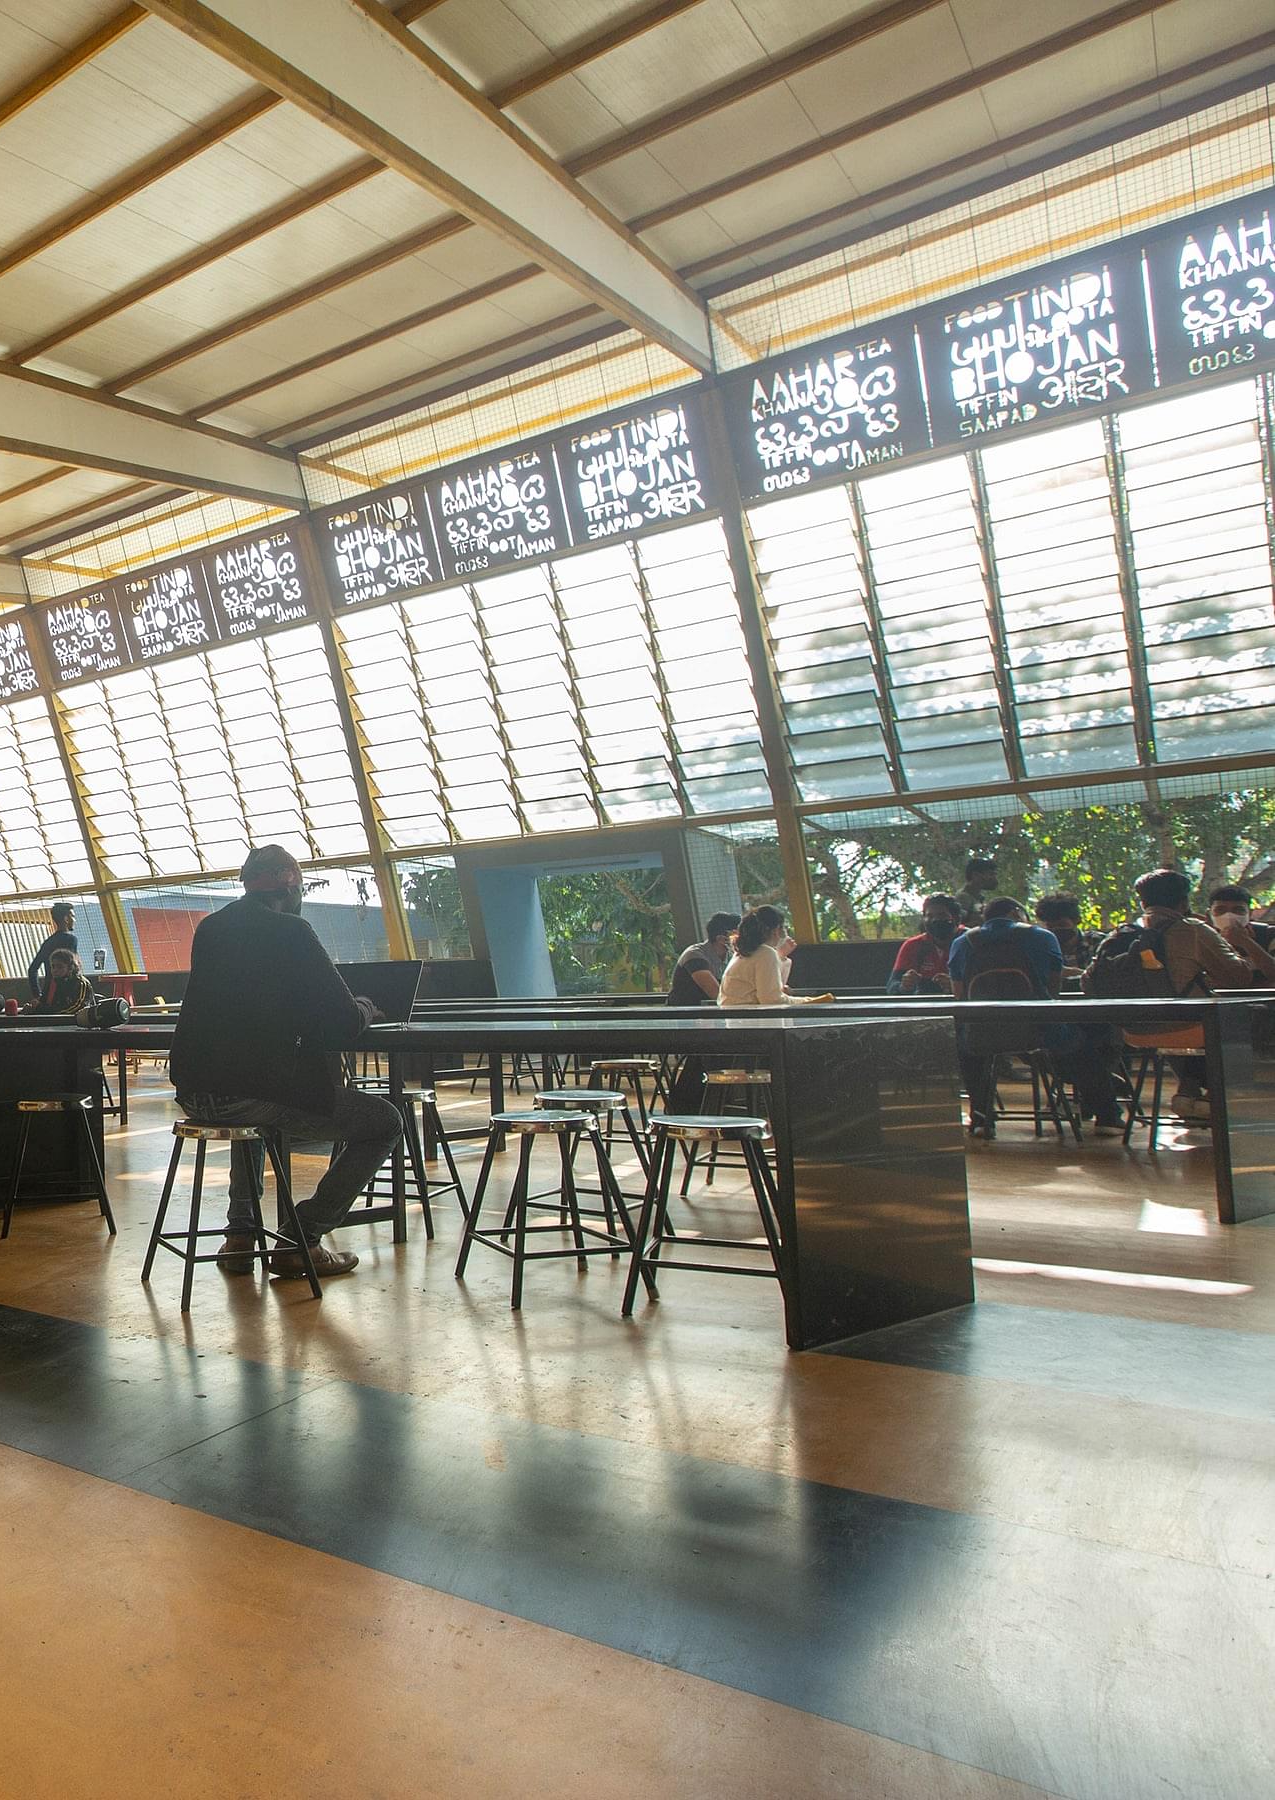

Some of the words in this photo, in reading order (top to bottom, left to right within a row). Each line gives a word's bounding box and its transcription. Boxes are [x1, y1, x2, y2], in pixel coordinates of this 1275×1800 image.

[944, 301, 1002, 333] FOOD
[1004, 265, 1112, 352] TINDI
[1050, 295, 1114, 332] OOTA
[1187, 312, 1262, 348] TIFFIN
[751, 350, 856, 408] AAHAR
[855, 338, 891, 360] TEA
[950, 322, 1118, 400] BHOJAN
[751, 388, 817, 421] KHAANA
[955, 386, 1018, 416] TIFFIN
[958, 403, 1038, 437] SAAPAD
[571, 429, 611, 452] FOOD
[611, 404, 686, 470] TINDI
[645, 429, 689, 456] OOTA
[760, 442, 812, 468] TIFFIN
[812, 439, 861, 465] OOTA
[441, 460, 516, 504] AAHAR
[514, 451, 540, 469] TEA
[578, 450, 695, 507] BHOJAN
[441, 490, 489, 516] KHAANA
[584, 498, 628, 521] TIFFIN
[328, 510, 358, 529] FOOD
[358, 492, 414, 547] TINDI
[384, 513, 417, 535] OOTA
[587, 512, 643, 538] SAAPAD
[215, 539, 273, 574] AAHAR
[270, 532, 290, 547] TEA
[335, 532, 423, 577] BHOJAN
[451, 535, 489, 555] TIFFIN
[489, 534, 525, 554] OOTA
[125, 579, 148, 594] FOOD
[148, 565, 192, 610] TINDI
[216, 564, 253, 584] KHAANA
[341, 570, 374, 589] TIFFIN
[169, 582, 195, 601] OOTA
[344, 583, 386, 604] SAAPAD
[47, 597, 92, 627] AAHAR
[89, 592, 105, 604] TEA
[132, 598, 201, 635] BHOJAN
[225, 602, 255, 618] TIFFIN
[255, 602, 283, 618] OOTA
[48, 619, 77, 636] KHAANA
[137, 630, 164, 645] TIFFIN
[57, 652, 80, 666] TIFFIN
[141, 641, 173, 658] SAAPAD
